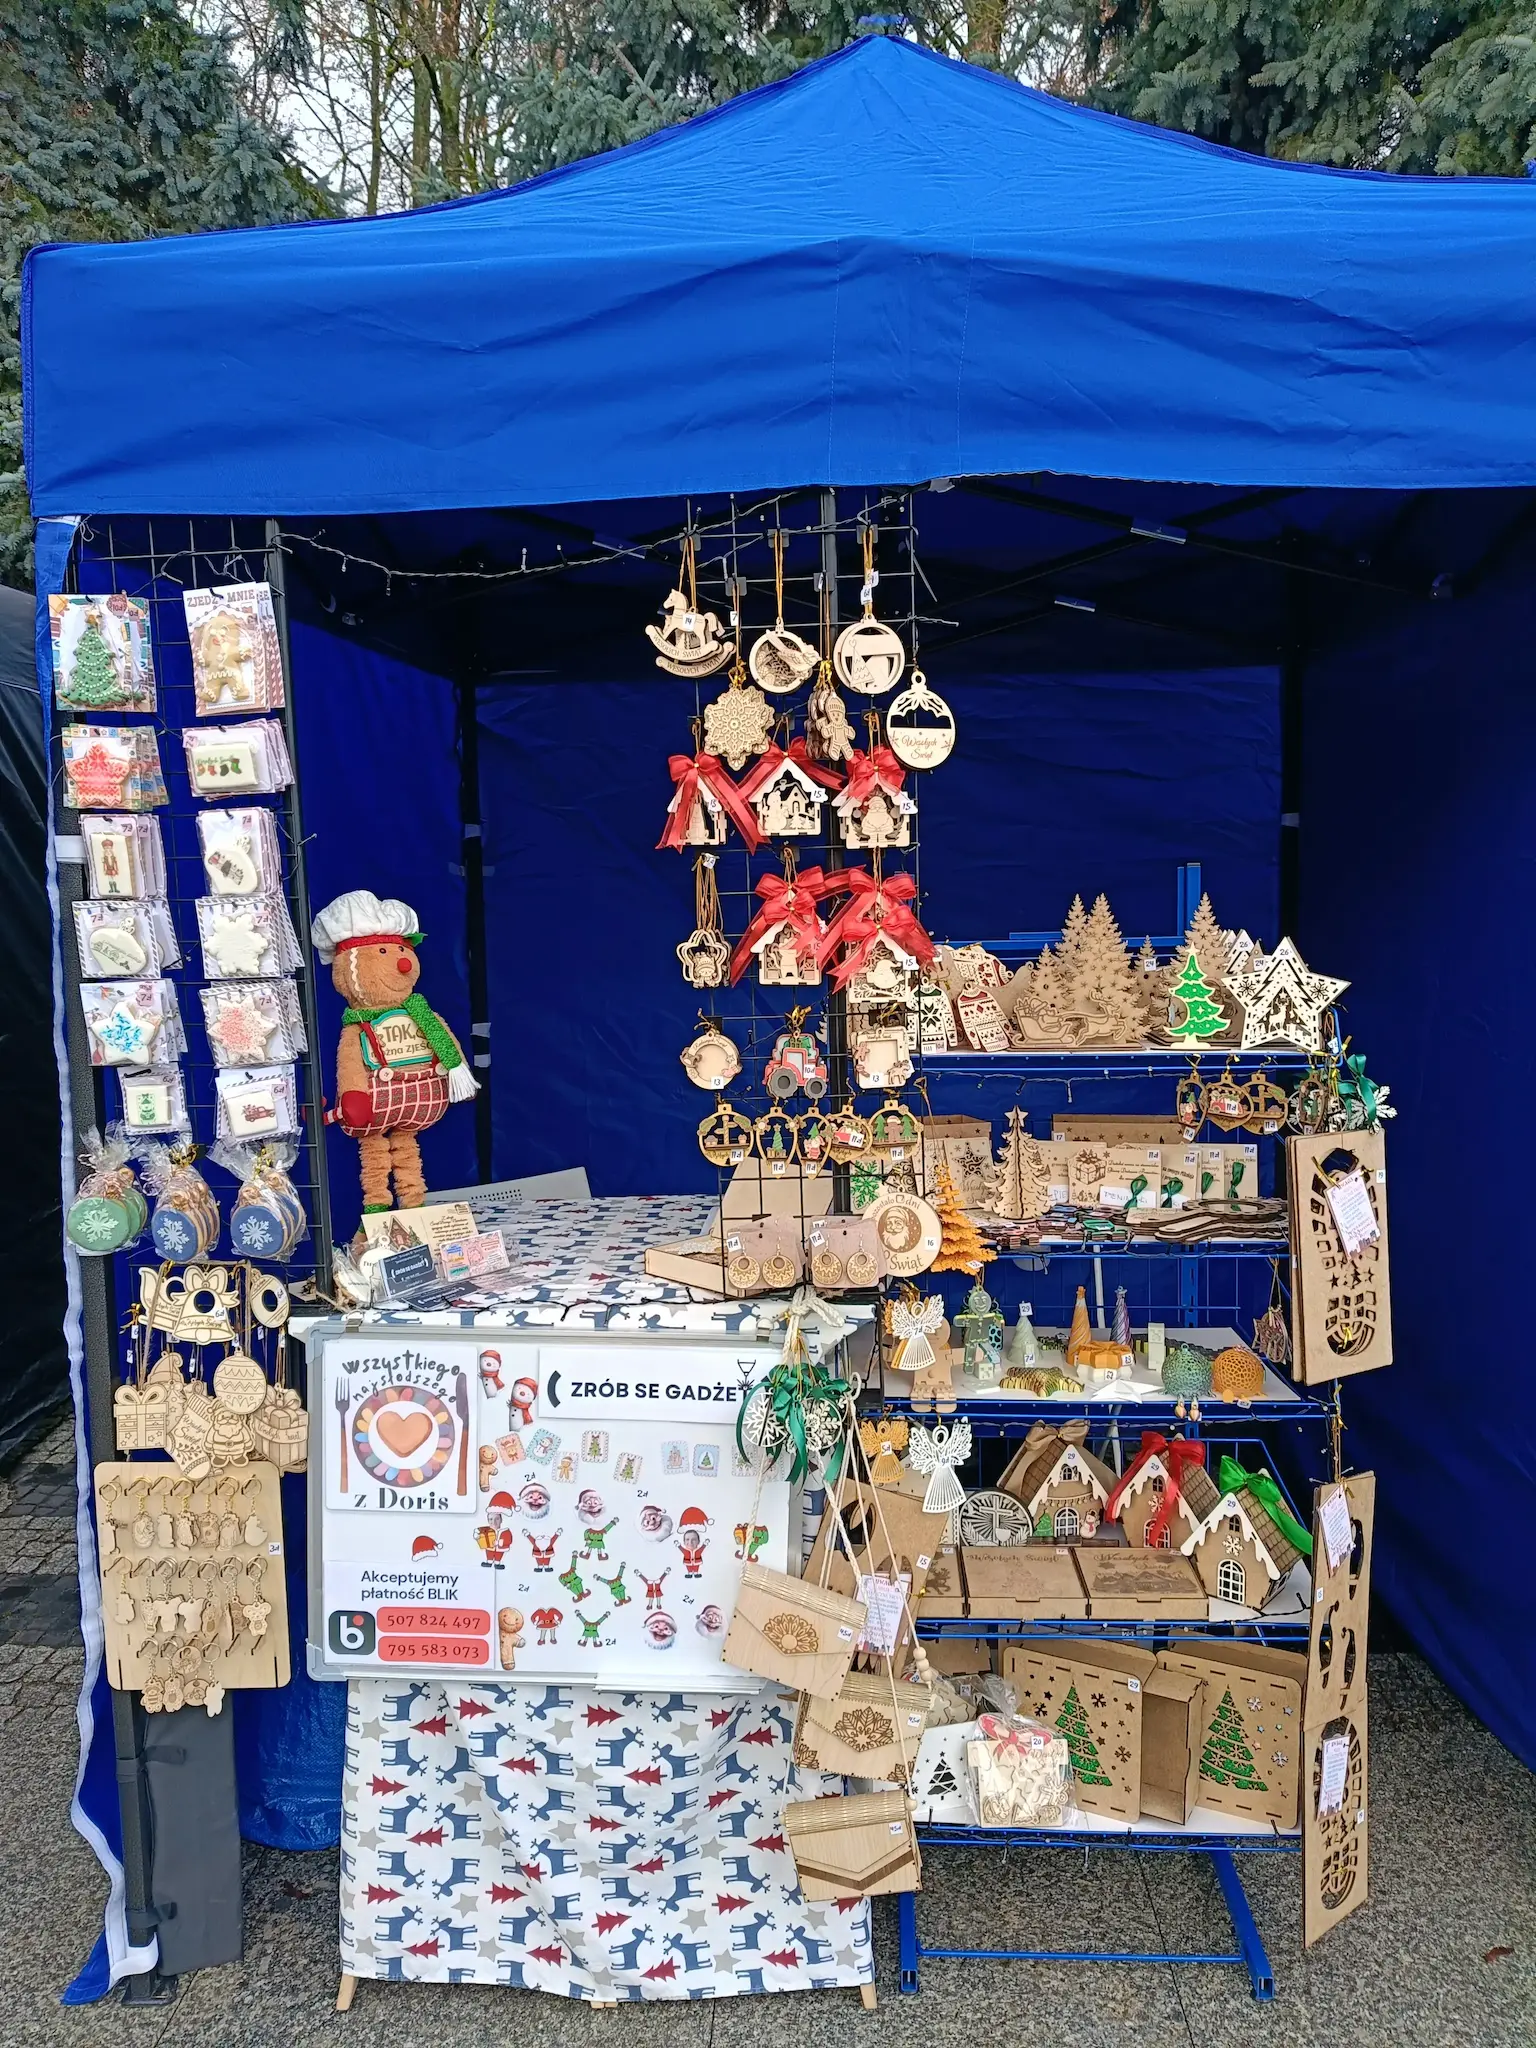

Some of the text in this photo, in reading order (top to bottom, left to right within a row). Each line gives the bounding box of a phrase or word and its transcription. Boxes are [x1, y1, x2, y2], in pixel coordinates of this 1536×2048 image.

[186, 596, 219, 608] ZJEDZ
[226, 589, 256, 601] MNIE
[812, 790, 822, 799] 15
[902, 802, 911, 811] 15
[905, 959, 914, 967] 15
[1145, 960, 1155, 968] 24
[1255, 959, 1264, 967] 24
[382, 1022, 416, 1043] TAK,
[713, 1078, 721, 1087] 13
[872, 1074, 880, 1083] 13
[905, 1196, 922, 1210] dni
[927, 1239, 934, 1247] 16
[889, 1253, 924, 1272] Świąt
[341, 1349, 461, 1382] wszystkiego
[352, 1371, 457, 1404] najsłodszego
[570, 1378, 629, 1398] ZRÓB
[635, 1383, 660, 1399] SE
[1067, 1452, 1076, 1460] 29
[1150, 1462, 1160, 1471] 29
[354, 1487, 449, 1511] z Doris
[1227, 1499, 1236, 1508] 29
[919, 1557, 928, 1566] 15
[361, 1570, 459, 1587] Akceptujemy
[361, 1587, 458, 1601] płatność BLIK
[387, 1614, 481, 1630] 507 824 497
[388, 1643, 480, 1659] 795 583 073
[1129, 1680, 1139, 1688] 29
[1033, 1737, 1042, 1746] 20
